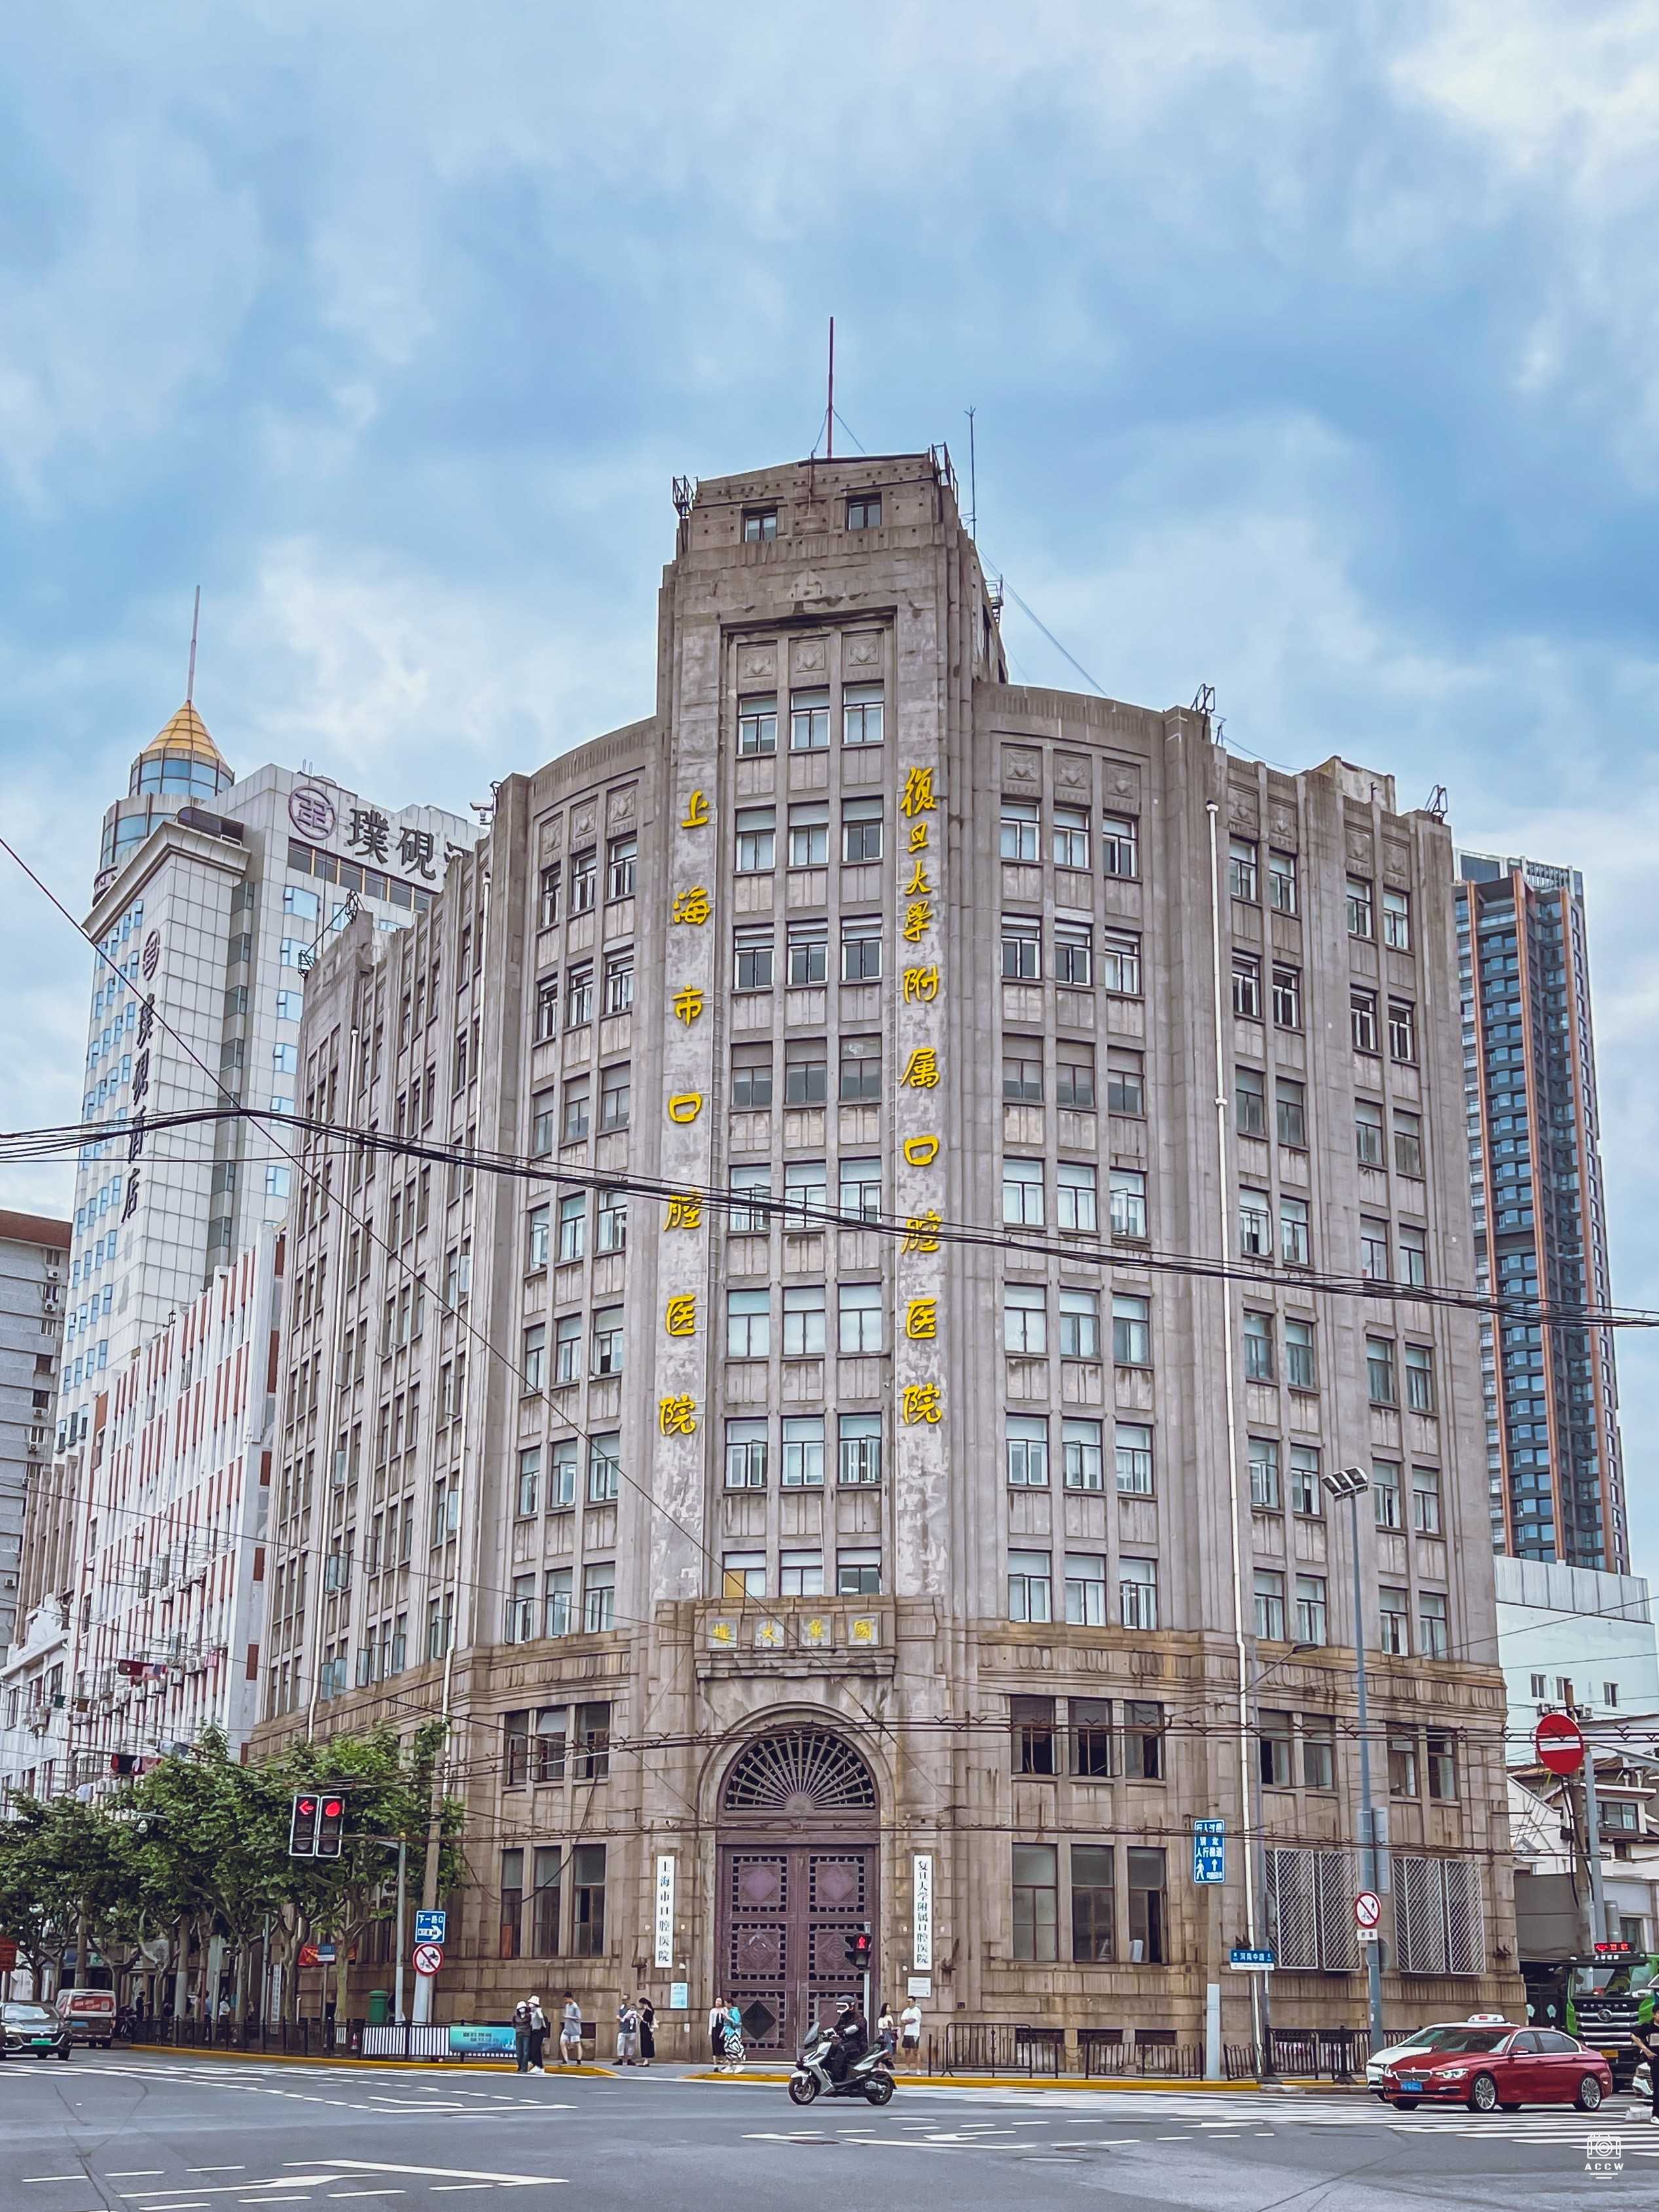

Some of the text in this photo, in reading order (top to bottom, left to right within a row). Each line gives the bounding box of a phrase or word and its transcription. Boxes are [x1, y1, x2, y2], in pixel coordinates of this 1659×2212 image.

[347, 808, 473, 880] 璞硯
[659, 789, 712, 1436] 上海市口腔医院
[658, 1861, 670, 1963] 上海市口腔医院
[917, 1860, 928, 1964] 复旦大学附属口腔医院
